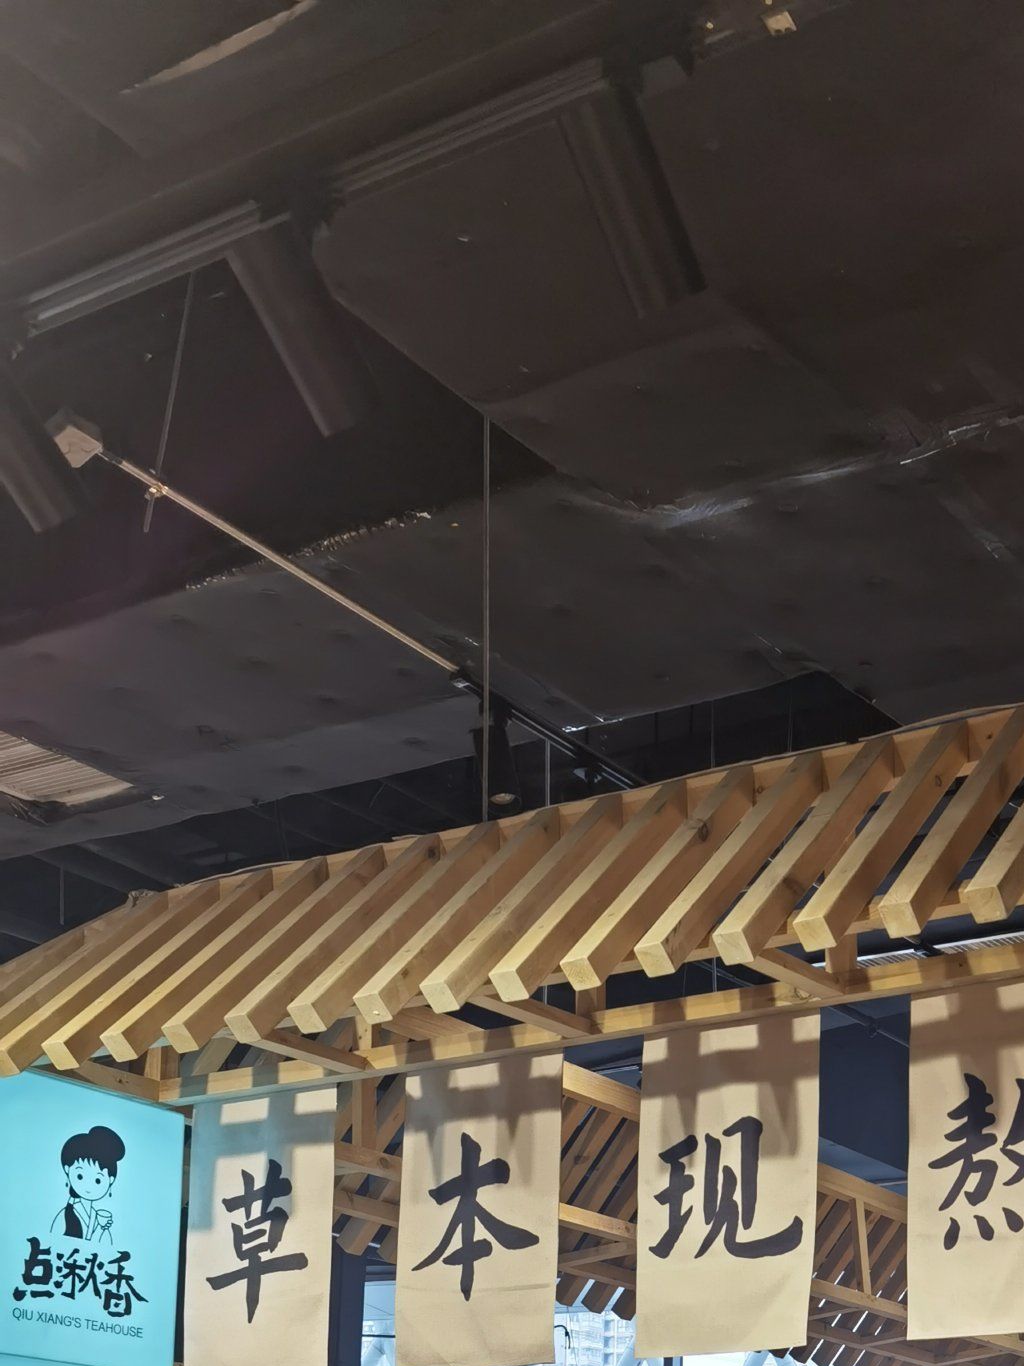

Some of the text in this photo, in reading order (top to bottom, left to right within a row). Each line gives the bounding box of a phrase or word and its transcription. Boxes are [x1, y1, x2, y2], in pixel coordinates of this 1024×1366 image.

[206, 1158, 308, 1324] 草
[411, 1132, 540, 1302] 本
[648, 1116, 804, 1260] 现
[12, 1307, 144, 1339] QIU XIANG'S TEAHOUSE
